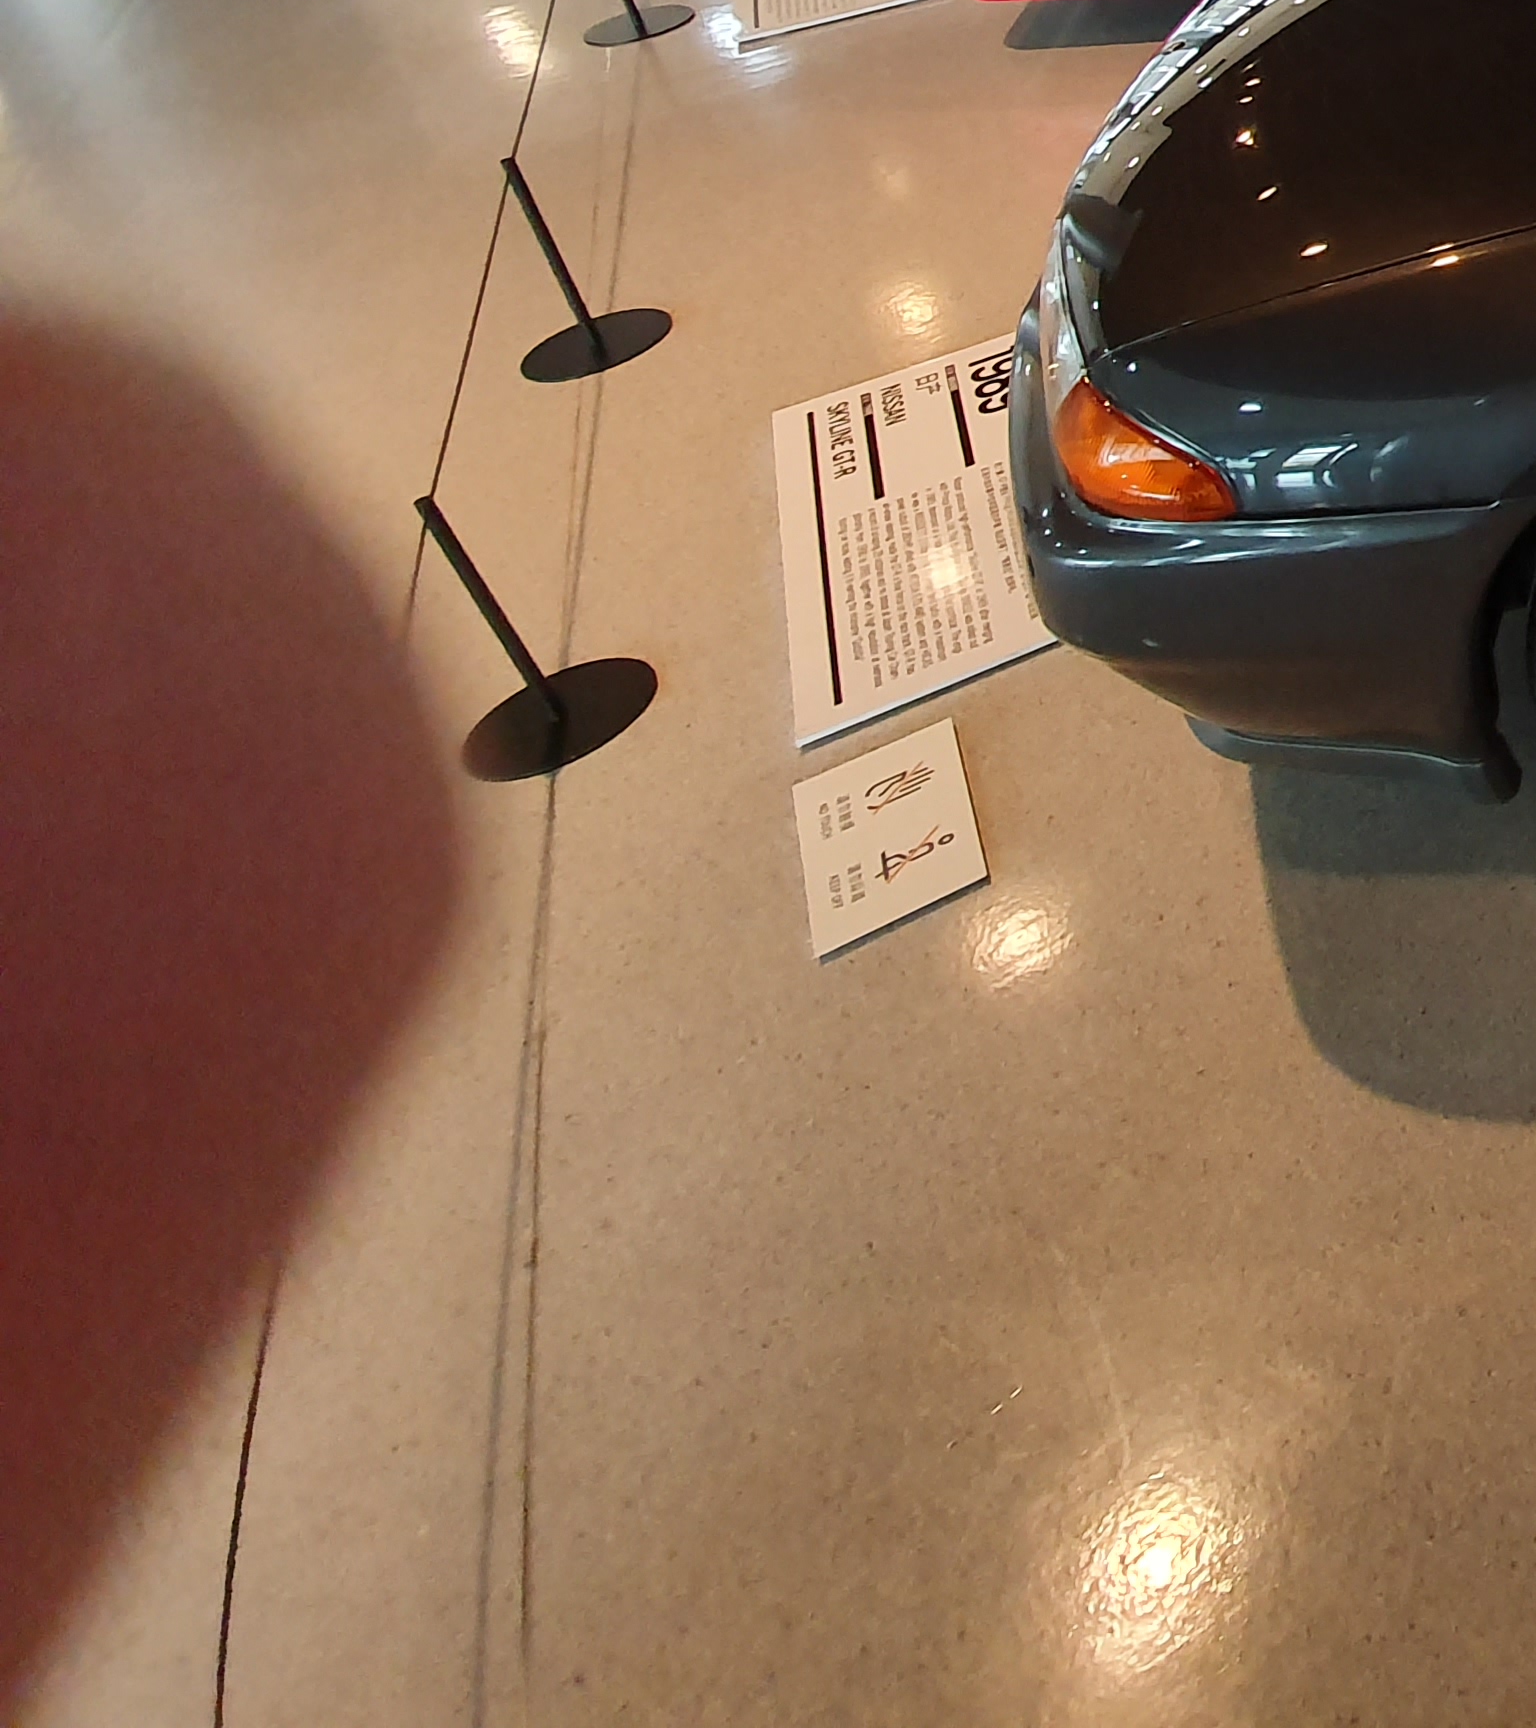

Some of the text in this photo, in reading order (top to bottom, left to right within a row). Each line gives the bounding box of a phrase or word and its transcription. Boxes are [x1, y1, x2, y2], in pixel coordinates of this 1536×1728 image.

[879, 382, 907, 427] NISSAN
[914, 371, 941, 395] 日产
[968, 344, 1016, 414] 1989
[826, 400, 857, 480] SKYLINE GT-R
